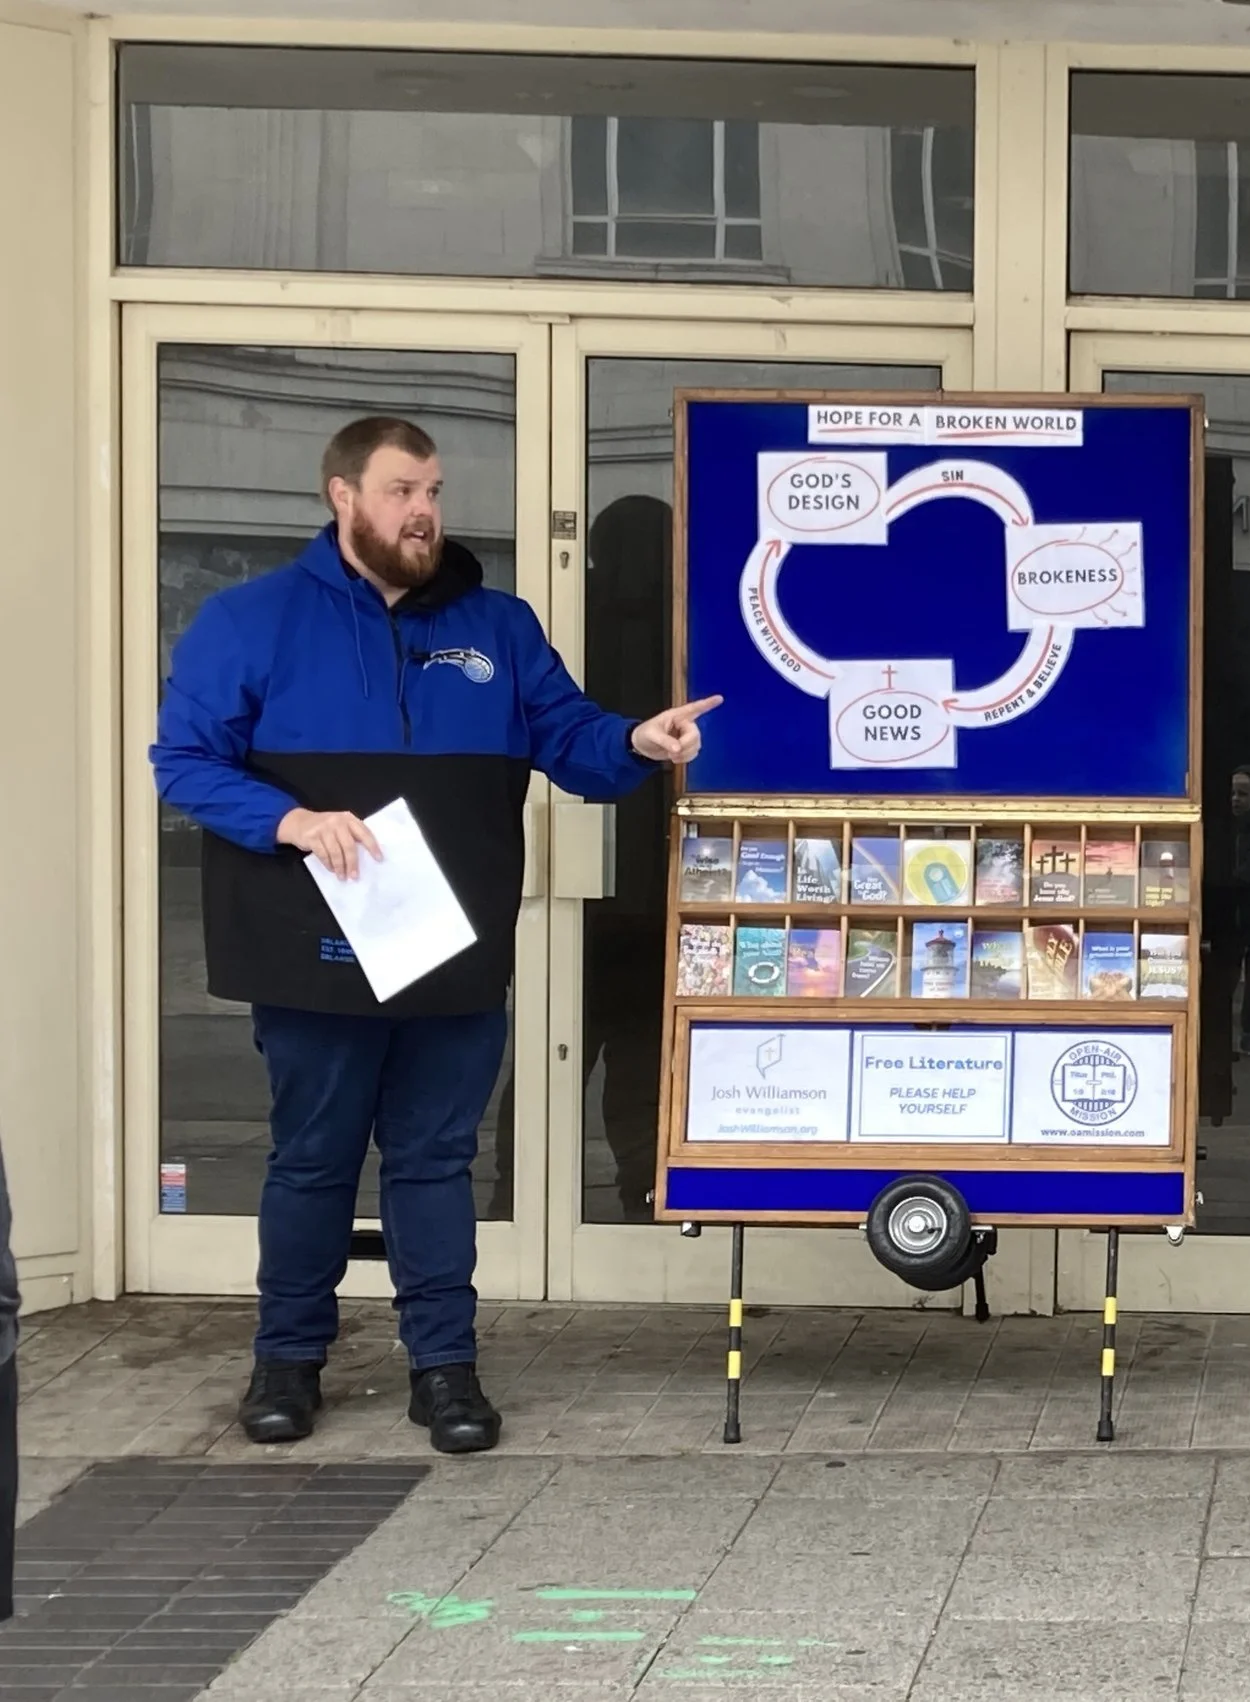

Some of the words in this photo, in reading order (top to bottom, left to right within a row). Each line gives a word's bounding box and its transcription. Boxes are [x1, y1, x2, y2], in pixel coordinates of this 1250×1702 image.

[817, 411, 863, 425] HOPE
[869, 412, 903, 426] FOR
[908, 412, 922, 426] A
[935, 415, 1008, 430] BROKEN
[1012, 416, 1077, 431] WORLD
[790, 473, 852, 489] GOD'S
[941, 470, 964, 482] SIN
[788, 494, 860, 511] DESIGN
[1017, 568, 1118, 586] BROKENESS
[748, 587, 765, 625] PEACE
[761, 626, 782, 654] WITH
[780, 653, 801, 672] GOD
[984, 695, 1026, 722] REPENT
[1033, 643, 1062, 689] BELIEVE
[863, 704, 922, 721] GOOD
[864, 725, 922, 742] NEWS
[797, 875, 818, 884] Life
[797, 884, 831, 893] Worth
[1068, 1045, 1122, 1063] OPEN-AIR
[865, 1056, 904, 1069] Free
[909, 1056, 1003, 1070] Literature
[711, 1084, 740, 1101] Josh
[745, 1085, 827, 1100] Williamson
[889, 1087, 940, 1098] PLEASE
[942, 1087, 976, 1099] HELP
[735, 1105, 800, 1116] evangelist
[899, 1103, 968, 1114] YOURSELF
[1069, 1106, 1117, 1122] MISSION
[1040, 1128, 1145, 1138] www.oamission.com
